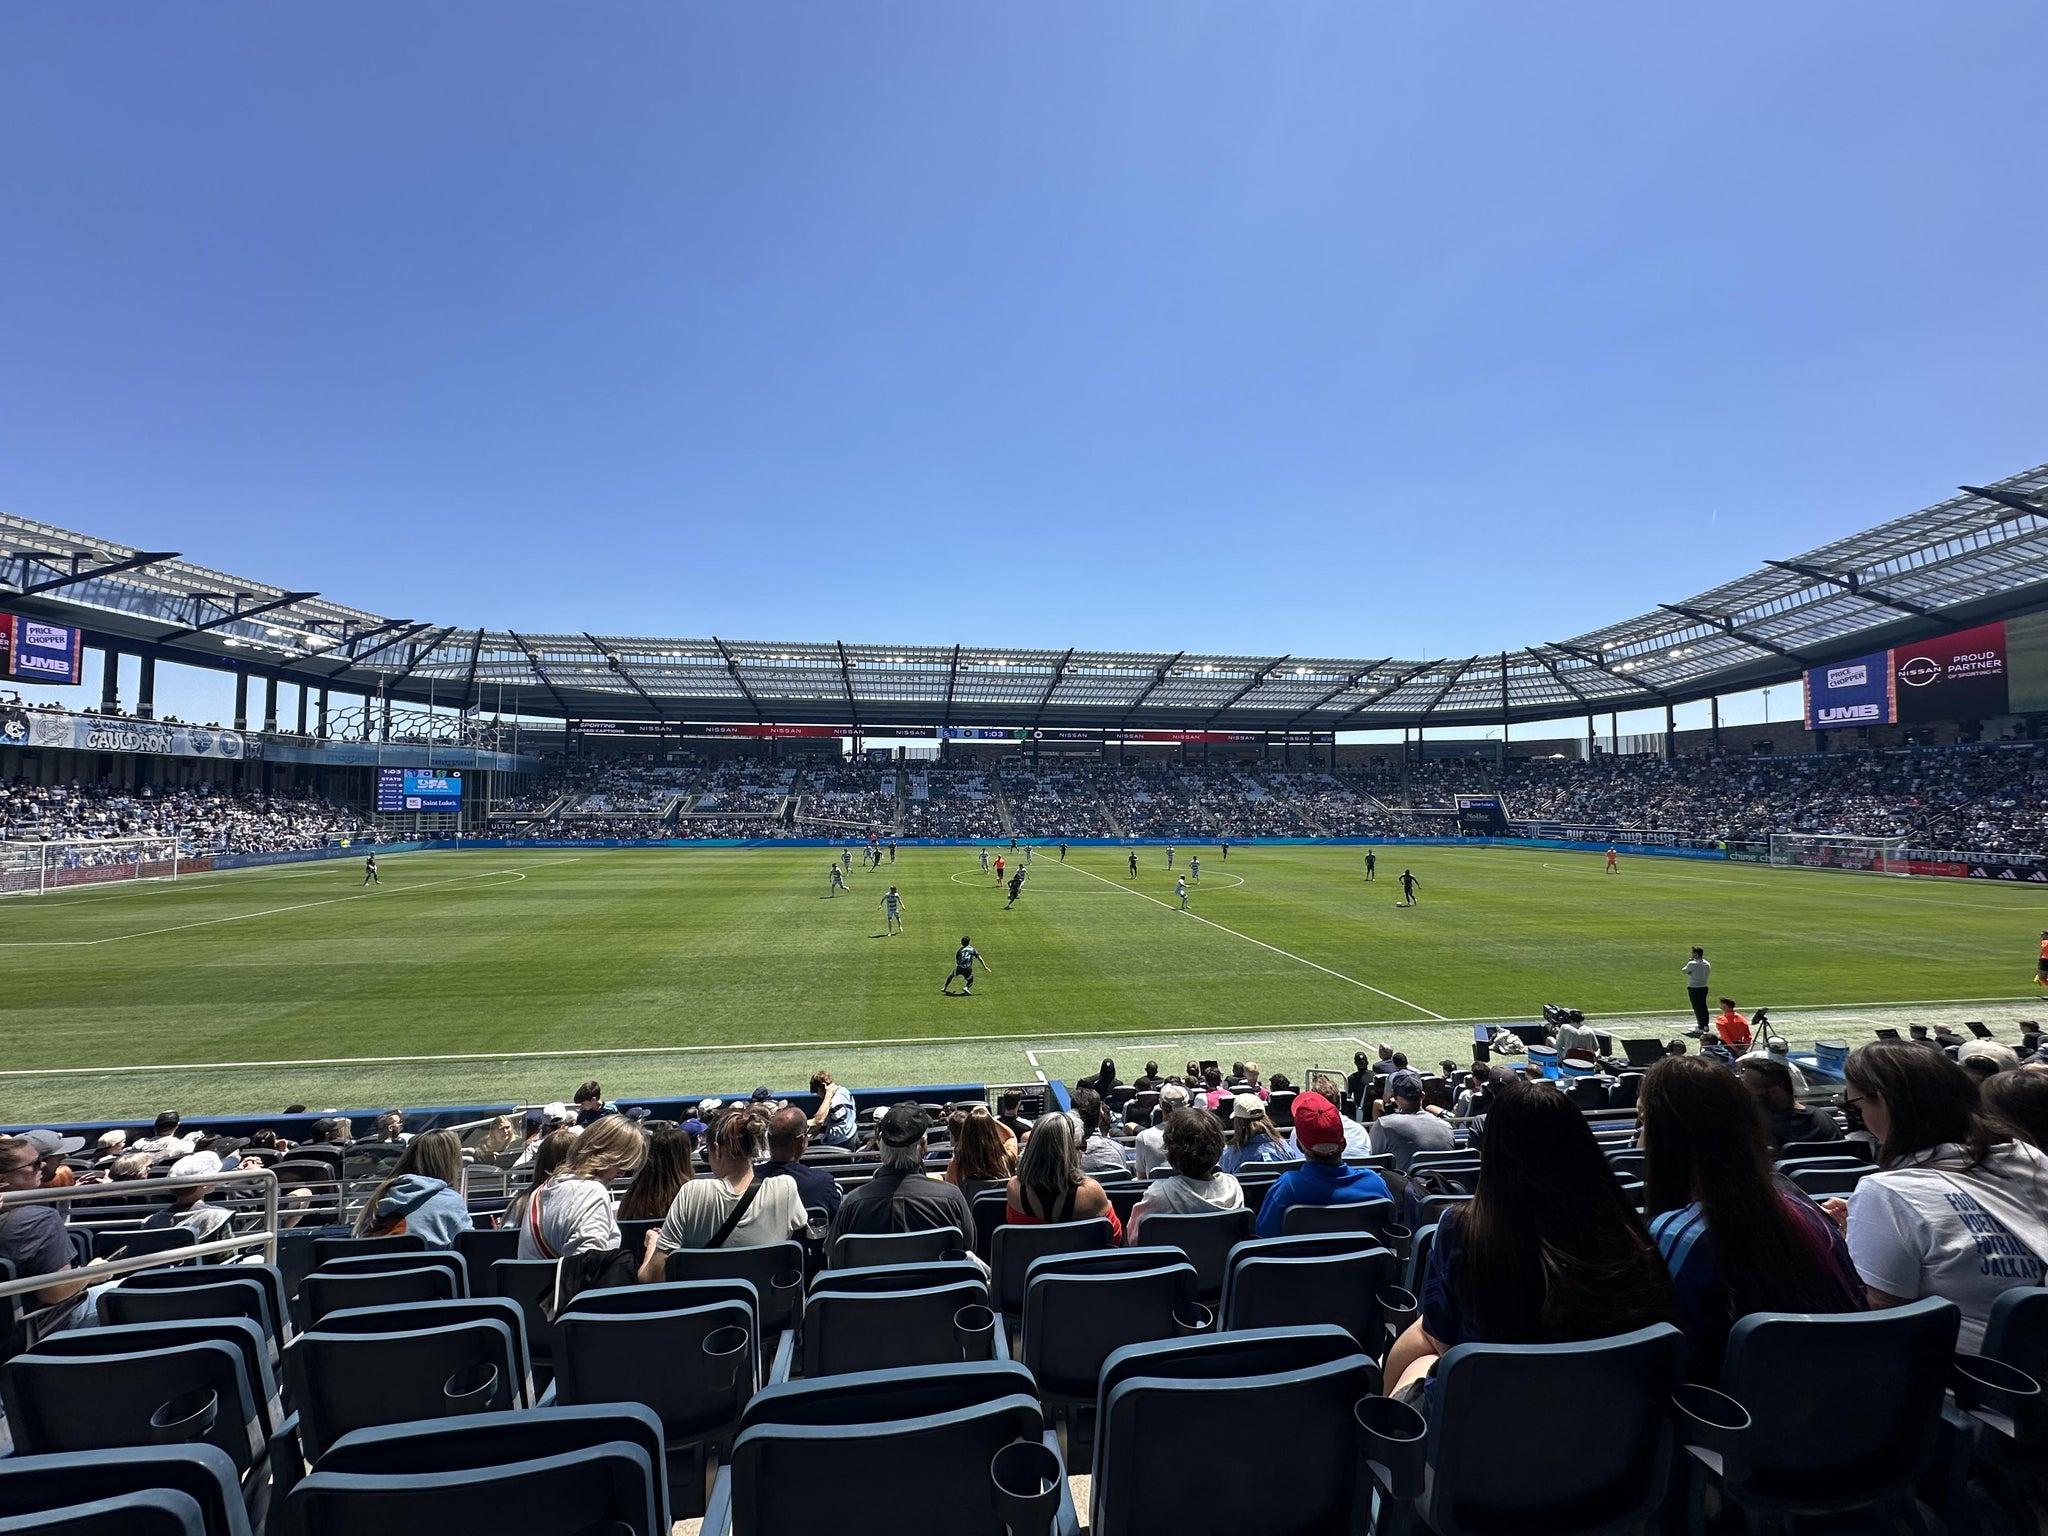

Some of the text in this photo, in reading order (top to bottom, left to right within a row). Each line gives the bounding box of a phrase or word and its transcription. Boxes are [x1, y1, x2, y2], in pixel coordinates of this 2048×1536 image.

[21, 654, 69, 671] UMB
[1953, 651, 1995, 663] PROUD
[1898, 666, 1941, 677] NISSAN
[1947, 660, 2002, 672] PARTNER
[1830, 669, 1851, 679] PRICE
[1830, 672, 1864, 687] CHOPPER
[1958, 670, 1991, 678] SPORTING
[1818, 704, 1879, 720] UMB
[86, 730, 173, 753] CAULDRON
[1730, 852, 1756, 861] chime
[1759, 854, 1788, 863] chime
